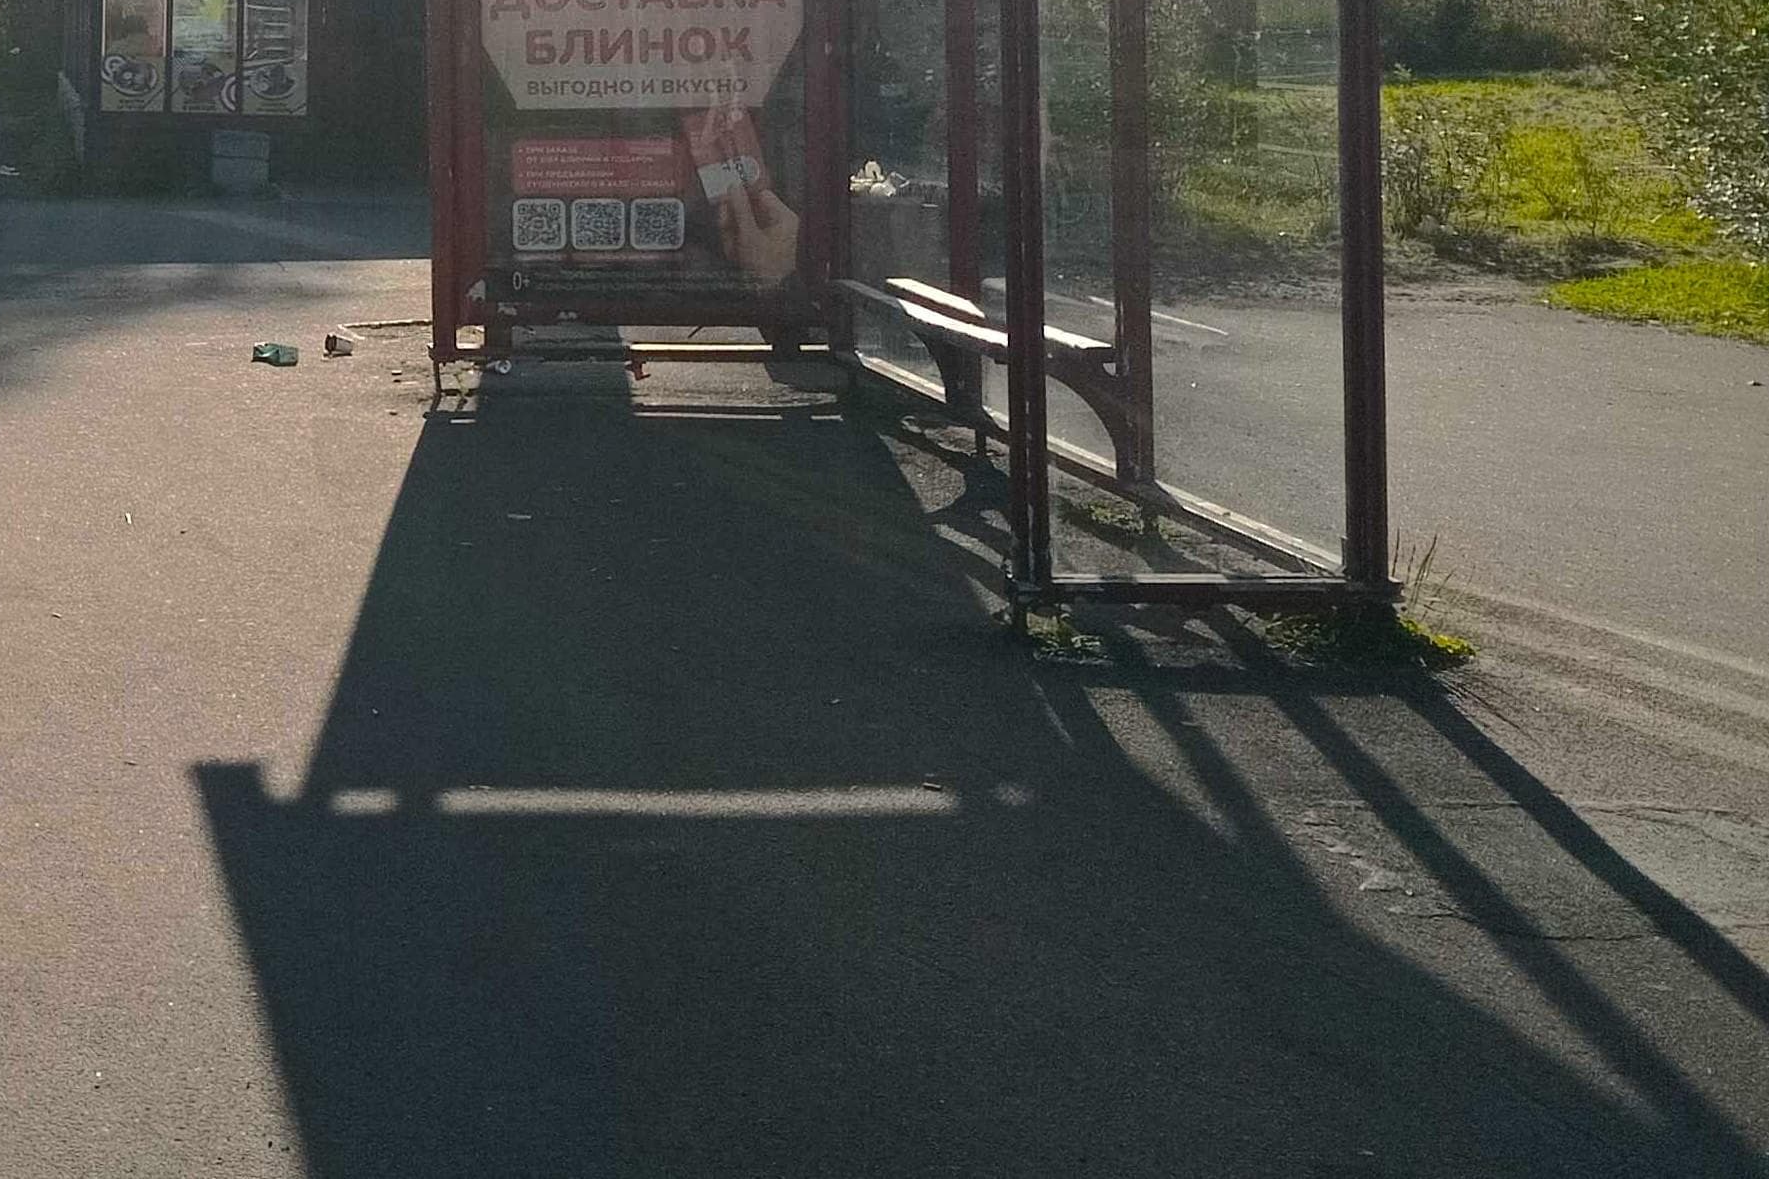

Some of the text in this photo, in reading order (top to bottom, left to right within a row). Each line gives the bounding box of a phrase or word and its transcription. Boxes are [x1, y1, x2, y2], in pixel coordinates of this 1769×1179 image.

[525, 26, 753, 65] БЛИНОК
[527, 78, 749, 97] ВЫГОДНО И ВКУСНО
[512, 271, 531, 291] 0+
